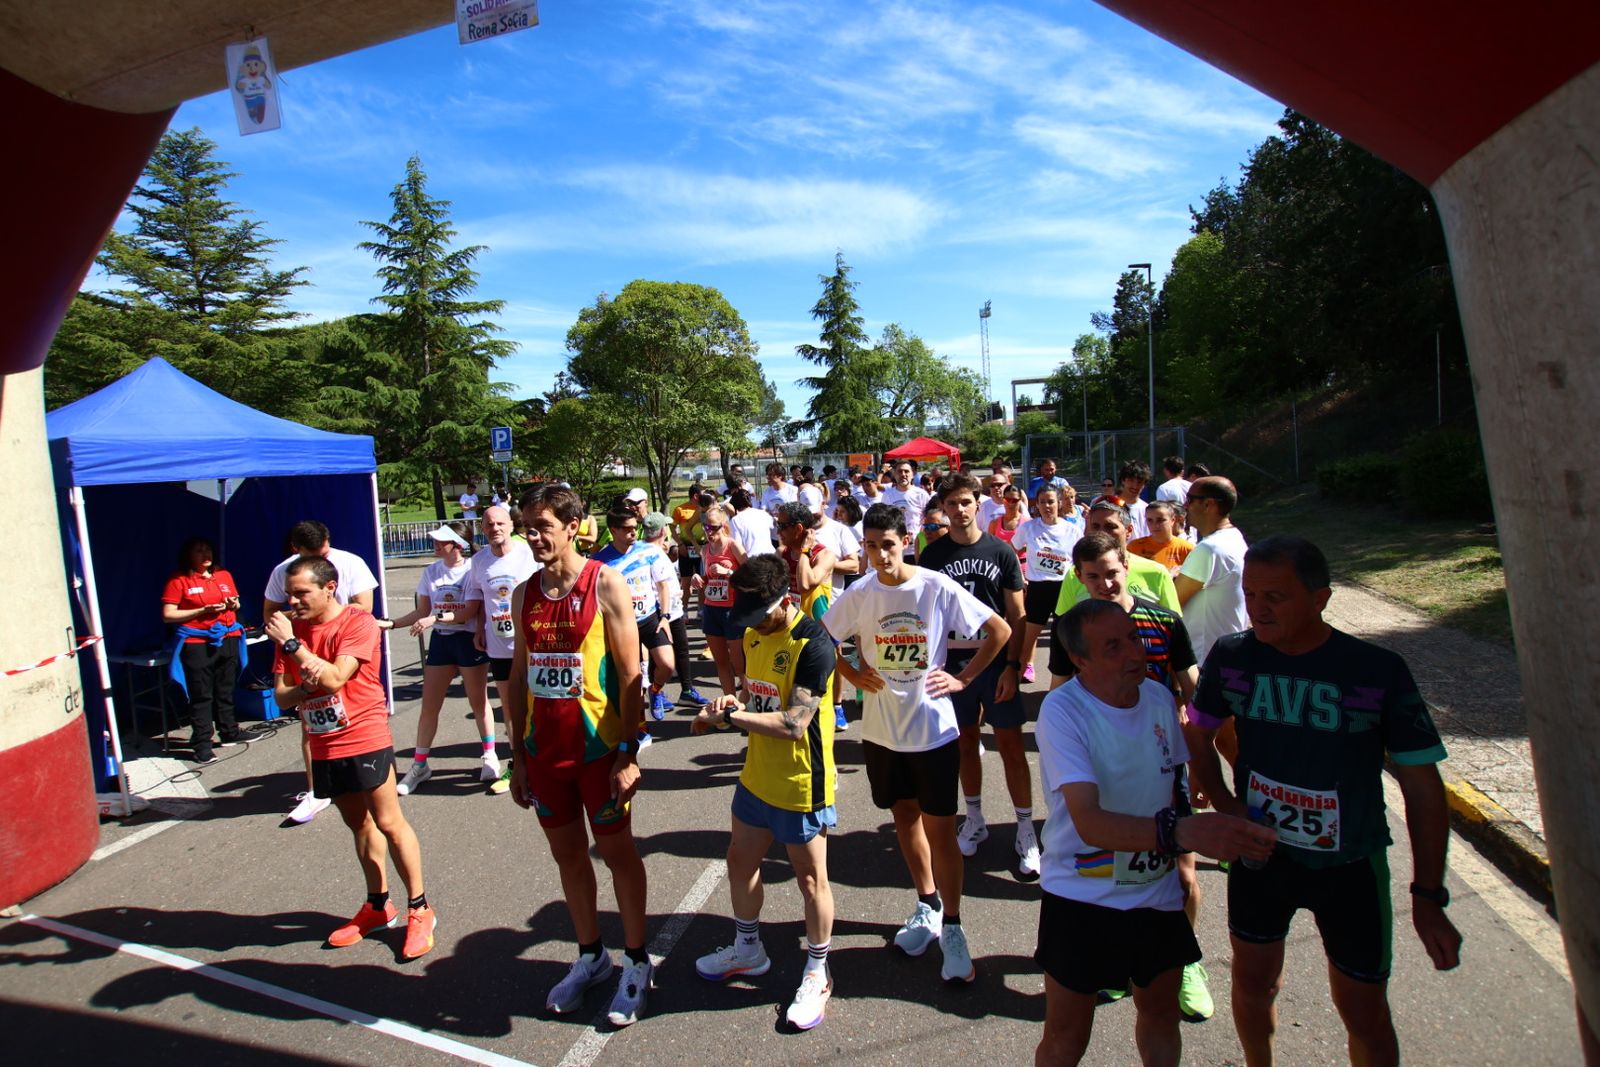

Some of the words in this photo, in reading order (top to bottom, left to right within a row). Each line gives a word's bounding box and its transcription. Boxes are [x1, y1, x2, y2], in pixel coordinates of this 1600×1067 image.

[466, 0, 513, 18] SOLIDA
[468, 22, 498, 40] Reina
[495, 430, 507, 449] P
[1040, 558, 1062, 570] 432
[708, 586, 724, 596] 391
[541, 632, 564, 641] VINO
[546, 641, 572, 650] TORO
[874, 633, 928, 645] bedunia
[529, 655, 582, 667] bedunia
[883, 644, 921, 662] 472
[535, 668, 573, 688] 480
[1247, 673, 1342, 732] AVS
[1249, 774, 1337, 811] bedunia
[1260, 798, 1323, 836] 425
